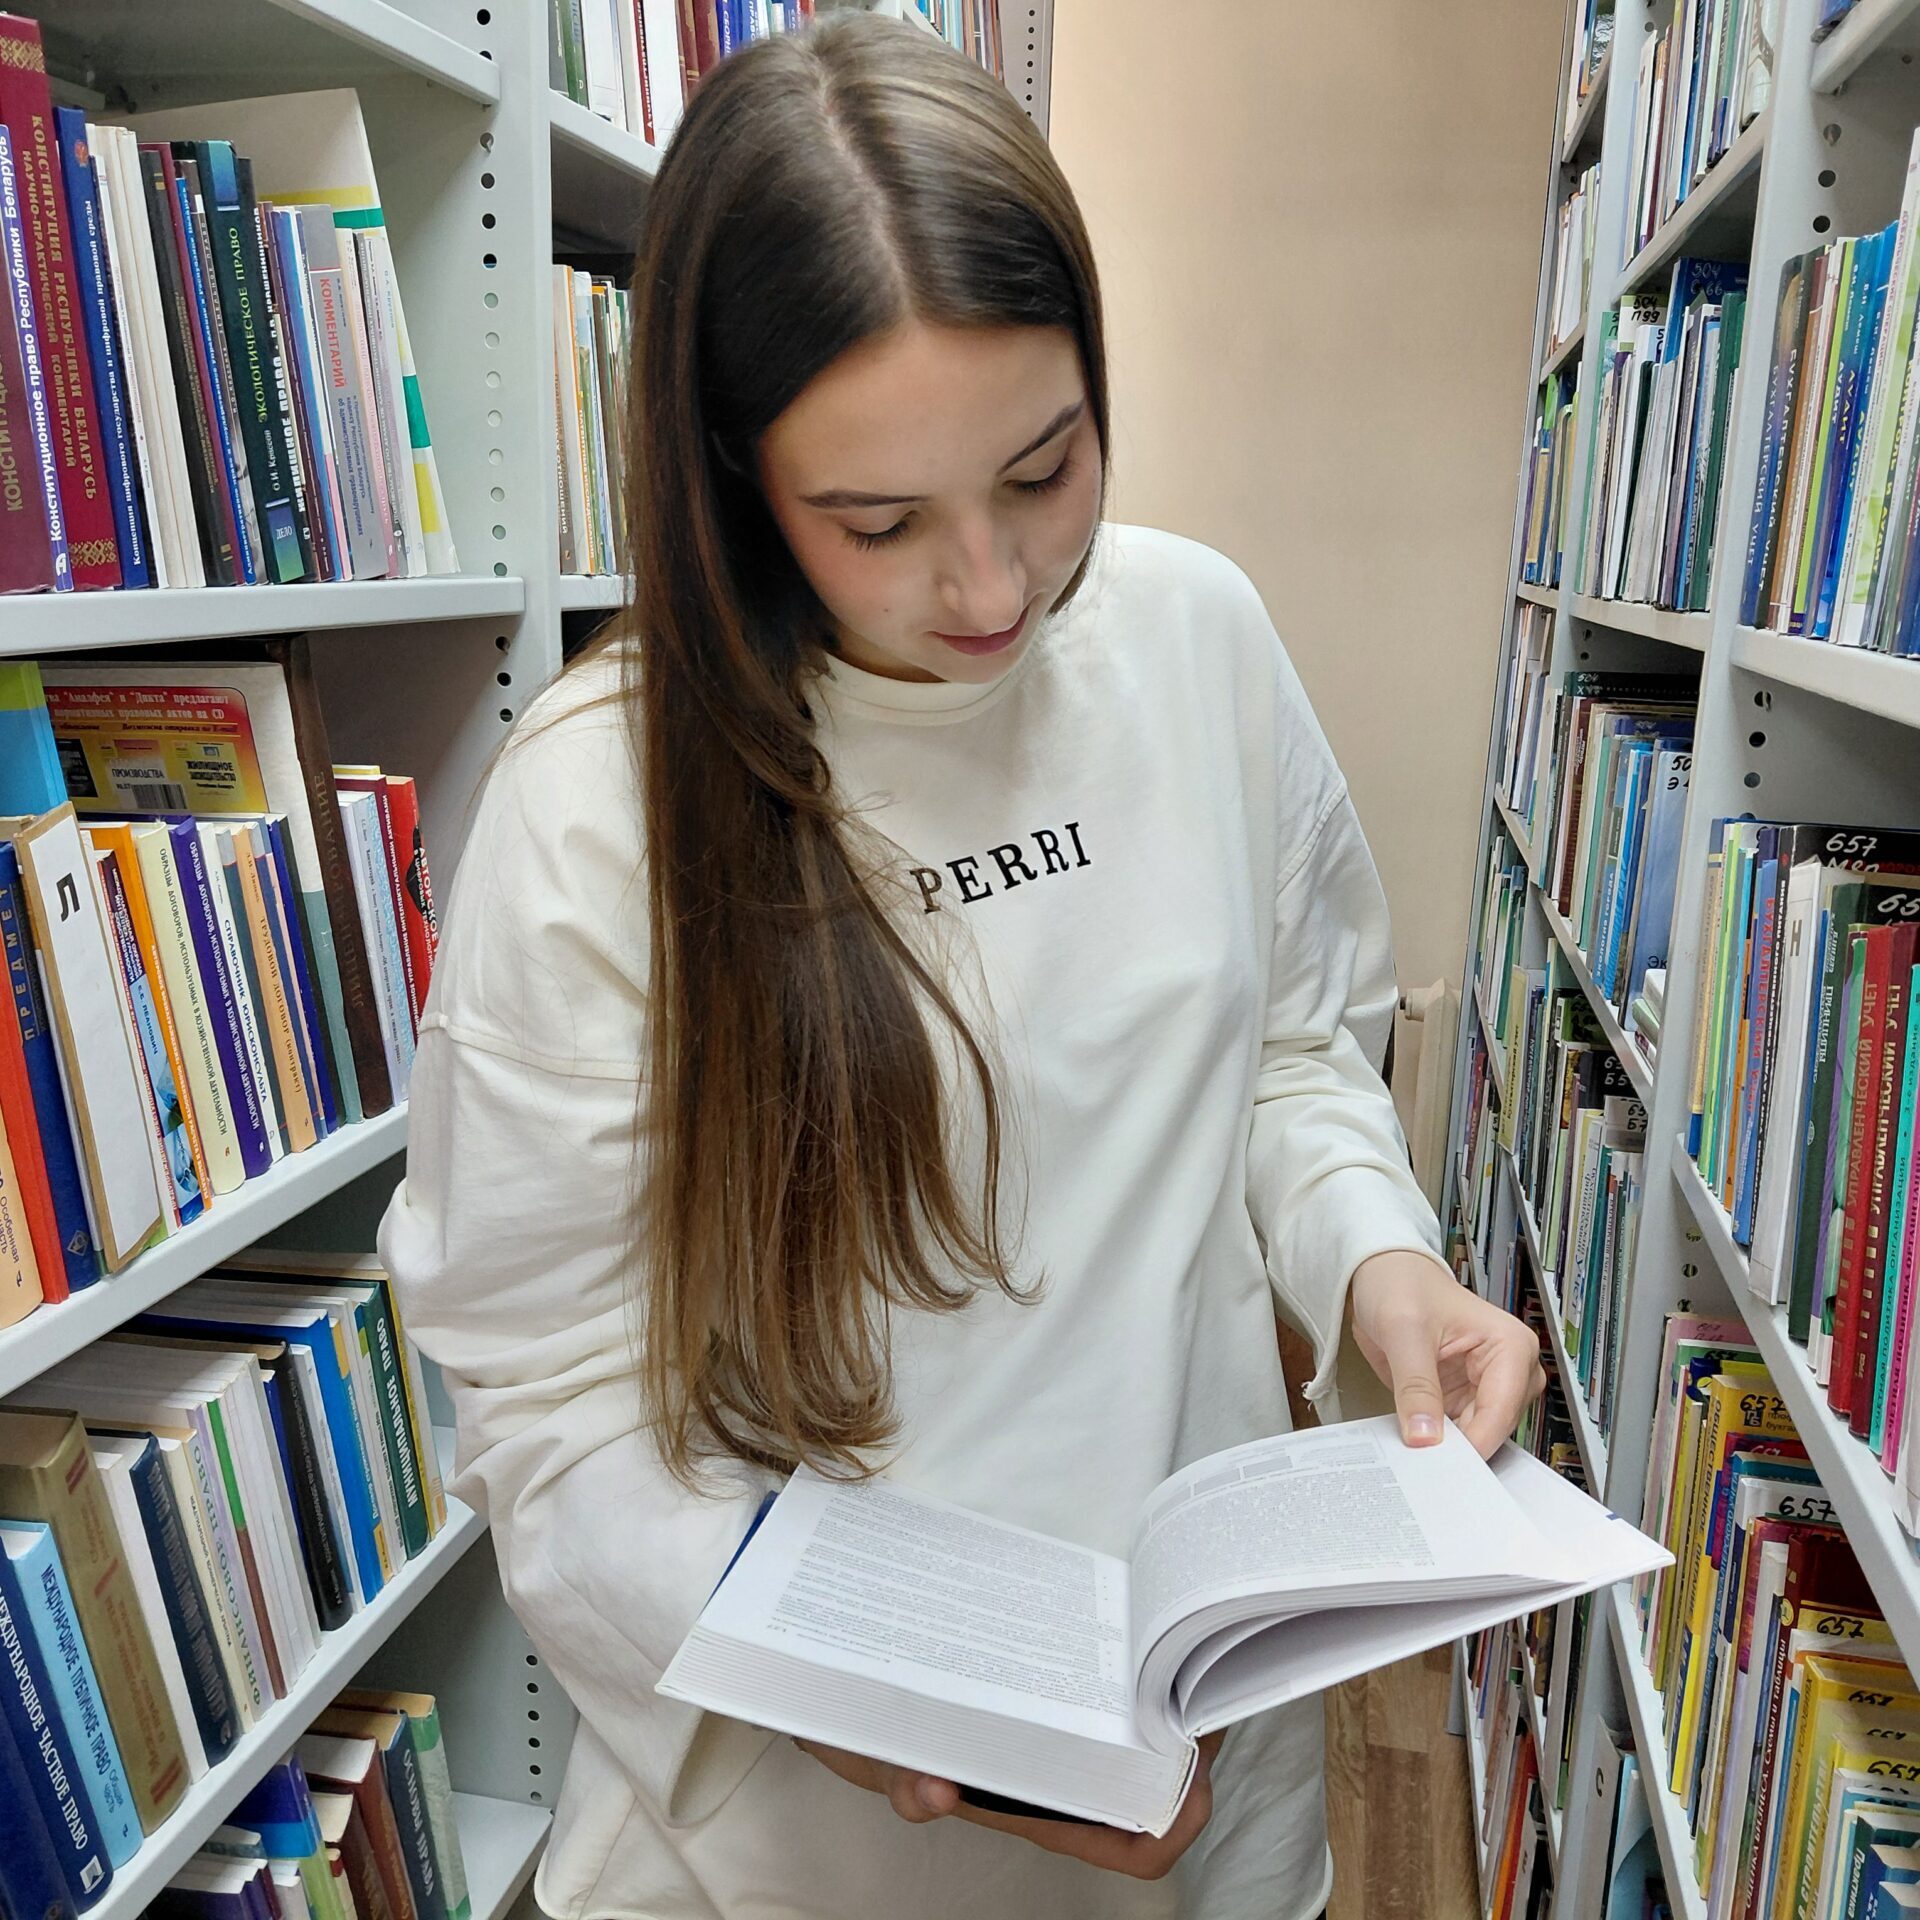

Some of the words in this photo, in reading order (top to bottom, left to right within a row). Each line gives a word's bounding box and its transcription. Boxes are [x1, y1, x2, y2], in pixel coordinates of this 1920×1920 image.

[0, 135, 17, 218] Беларусь
[7, 226, 33, 328] Республики
[89, 239, 105, 294] правовой
[226, 226, 246, 281] ПРАВО
[1691, 263, 1720, 279] 504
[20, 149, 58, 344] НАУЧНО-ПРАКТИЧЕСКИЙ
[50, 353, 76, 467] КОММЕНТАРИЙ
[30, 114, 62, 262] КОНСТИТУЦИЯ
[52, 270, 81, 398] РЕСПУБЛИКИ
[72, 405, 96, 499] БЕЛАРУСЬ
[97, 297, 113, 355] цифровой
[319, 277, 346, 388] КОММЕНТАРИЙ
[22, 333, 41, 385] право
[105, 358, 115, 366] и
[236, 286, 269, 423] ЭКОЛОГИЧЕСКОЕ
[273, 355, 290, 411] ПРАВО
[1830, 360, 1844, 423] АУДИТ
[107, 370, 124, 438] государства
[1753, 365, 1779, 513] БУХГАЛТЕРСКИЙ
[1766, 348, 1797, 528] БУХГАЛТЕРСКИЙ
[1838, 369, 1855, 444] АУДИТ
[1888, 359, 1914, 471] КОНТРОЛЬ
[30, 389, 63, 542] Конституционное
[117, 441, 133, 501] цифрового
[1846, 410, 1865, 490] АУДИТ
[1884, 481, 1892, 495] И
[125, 504, 142, 565] Концепция
[276, 525, 293, 540] ДЕЛО
[1746, 523, 1758, 566] УЧЕТ
[1757, 539, 1770, 590] УЧЕТ
[1870, 506, 1888, 573] АУДИТ
[381, 794, 393, 839] АКТИВАМИ
[1826, 833, 1878, 857] 657
[57, 872, 80, 922] Л
[413, 857, 426, 908] ЦИФРОВЫХ
[416, 847, 440, 941] АВТОРСКОЕ
[909, 821, 1092, 915] PERRI
[1595, 918, 1608, 976] ЭКОЛОГИЯ
[1604, 871, 1615, 916] ГОРОДА
[0, 887, 35, 1040] ПРЕДМЕТ
[158, 848, 173, 886] ОБРАЗЦЫ
[167, 889, 185, 942] ДОГОВОРОВ,
[179, 942, 198, 1004] ИСПОЛЬЗУЕМЫХ
[194, 1014, 214, 1079] ХОЗЯЙСТВЕННОЙ
[209, 1079, 227, 1135] ДЕЯТЕЛЬНОСТИ
[188, 841, 203, 880] ОБРАЗЦЫ
[198, 883, 215, 935] ДОГОВОРОВ,
[209, 934, 229, 998] ИСПОЛЬЗУЕМЫХ
[225, 1007, 246, 1072] ХОЗЯЙСТВЕННОЙ
[240, 1073, 259, 1129] ДЕЯТЕЛЬНОСТИ
[1751, 896, 1775, 1058] БУХГАЛТЕРСКИЙ
[1766, 941, 1780, 1046] ОБЩЕСТВЕННОГО
[1776, 879, 1786, 938] ПИТАНИЯ
[223, 919, 246, 999] СПРАВОЧНИК
[241, 1003, 268, 1103] ЮРИСКОНСУЛЬТА
[258, 918, 277, 978] ТРУДОВОЙ
[272, 982, 289, 1035] ДОГОВОР
[284, 1038, 302, 1093] (контракт)
[1817, 985, 1834, 1063] ПРИНЦИПЫ
[1846, 1038, 1872, 1207] УПРАВЛЕНЧЕСКИЙ
[1864, 982, 1878, 1026] УЧЕТ
[1869, 1040, 1896, 1214] УПРАВЛЕНЧЕСКИЙ
[1887, 984, 1902, 1030] УЧЕТ
[1, 1196, 20, 1264] Особенная
[1873, 1362, 1886, 1429] УЧЕТНАЯ
[1880, 1275, 1894, 1356] ПОЛИТИКА
[1889, 1156, 1906, 1266] ОРГАНИЗАЦИИ
[373, 1316, 394, 1371] ПРАВО
[384, 1374, 420, 1507] МУНИЦИПАЛЬНОЕ
[1696, 1399, 1723, 1533] ОБЩЕСТВЕННОЕ
[191, 1445, 219, 1529] ПРАВО
[1778, 1496, 1837, 1521] 657
[1685, 1543, 1703, 1615] ПИТАНИЕ
[214, 1538, 263, 1705] ФИНАНСОВОЕ
[1816, 1616, 1865, 1638] 657
[41, 1564, 80, 1670] МЕЖДУНАРОДНОЕ
[69, 1667, 100, 1740] ПУБЛИЧНОЕ
[86, 1731, 111, 1776] ПРАВО
[1773, 1638, 1788, 1699] таблицы
[1764, 1715, 1777, 1764] Схемы
[1771, 1703, 1779, 1712] и
[39, 1726, 68, 1803] ЧАСТНОЕ
[62, 1792, 89, 1852] ПРАВО
[403, 1748, 424, 1828] ОСНОВЫ
[414, 1819, 436, 1898] ПРАВА
[1753, 1769, 1769, 1840] БИЗНЕСА.
[1744, 1843, 1759, 1909] ОЦЕНКА
[1847, 1847, 1866, 1918] Практика
